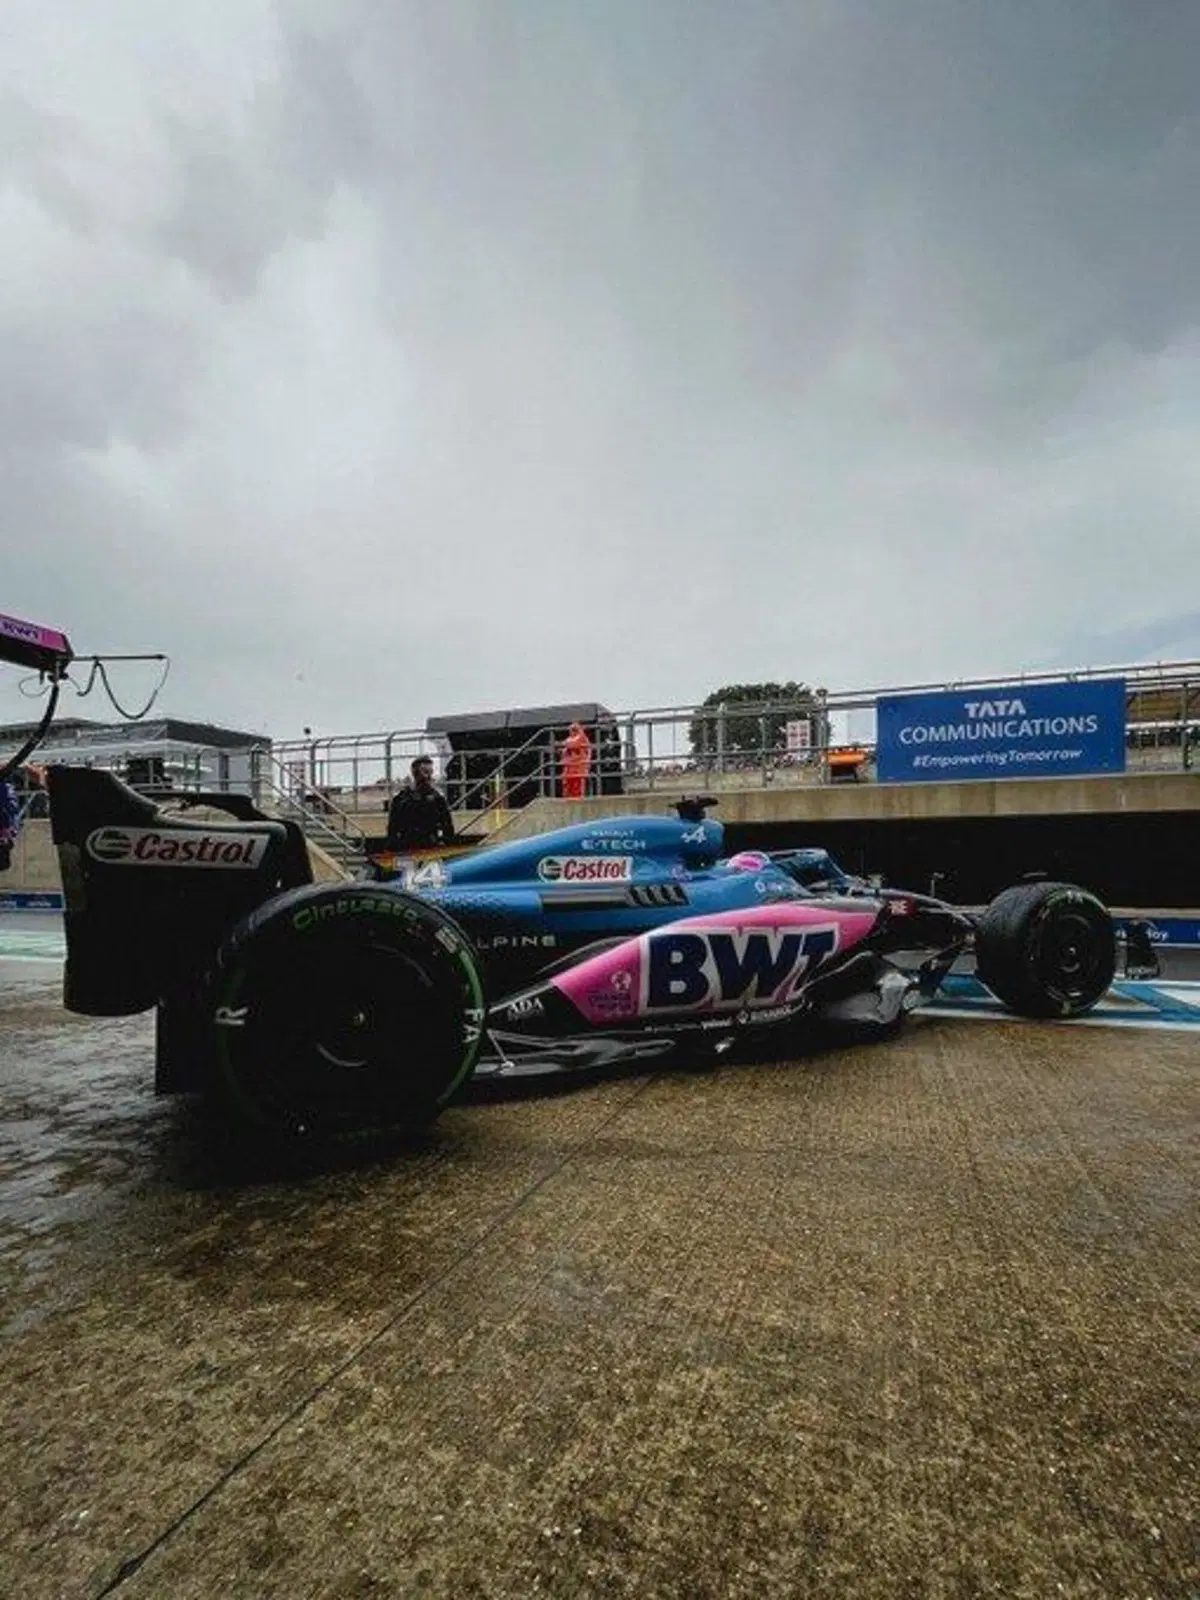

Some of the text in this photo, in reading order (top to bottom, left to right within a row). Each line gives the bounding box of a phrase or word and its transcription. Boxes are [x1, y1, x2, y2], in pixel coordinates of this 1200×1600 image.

[964, 699, 1027, 718] TATA
[898, 715, 1098, 744] COMMUNICATIONS
[134, 832, 256, 864] Castrol
[563, 858, 630, 881] Castrol
[476, 934, 557, 950] LPINE
[646, 926, 838, 1010] BWT
